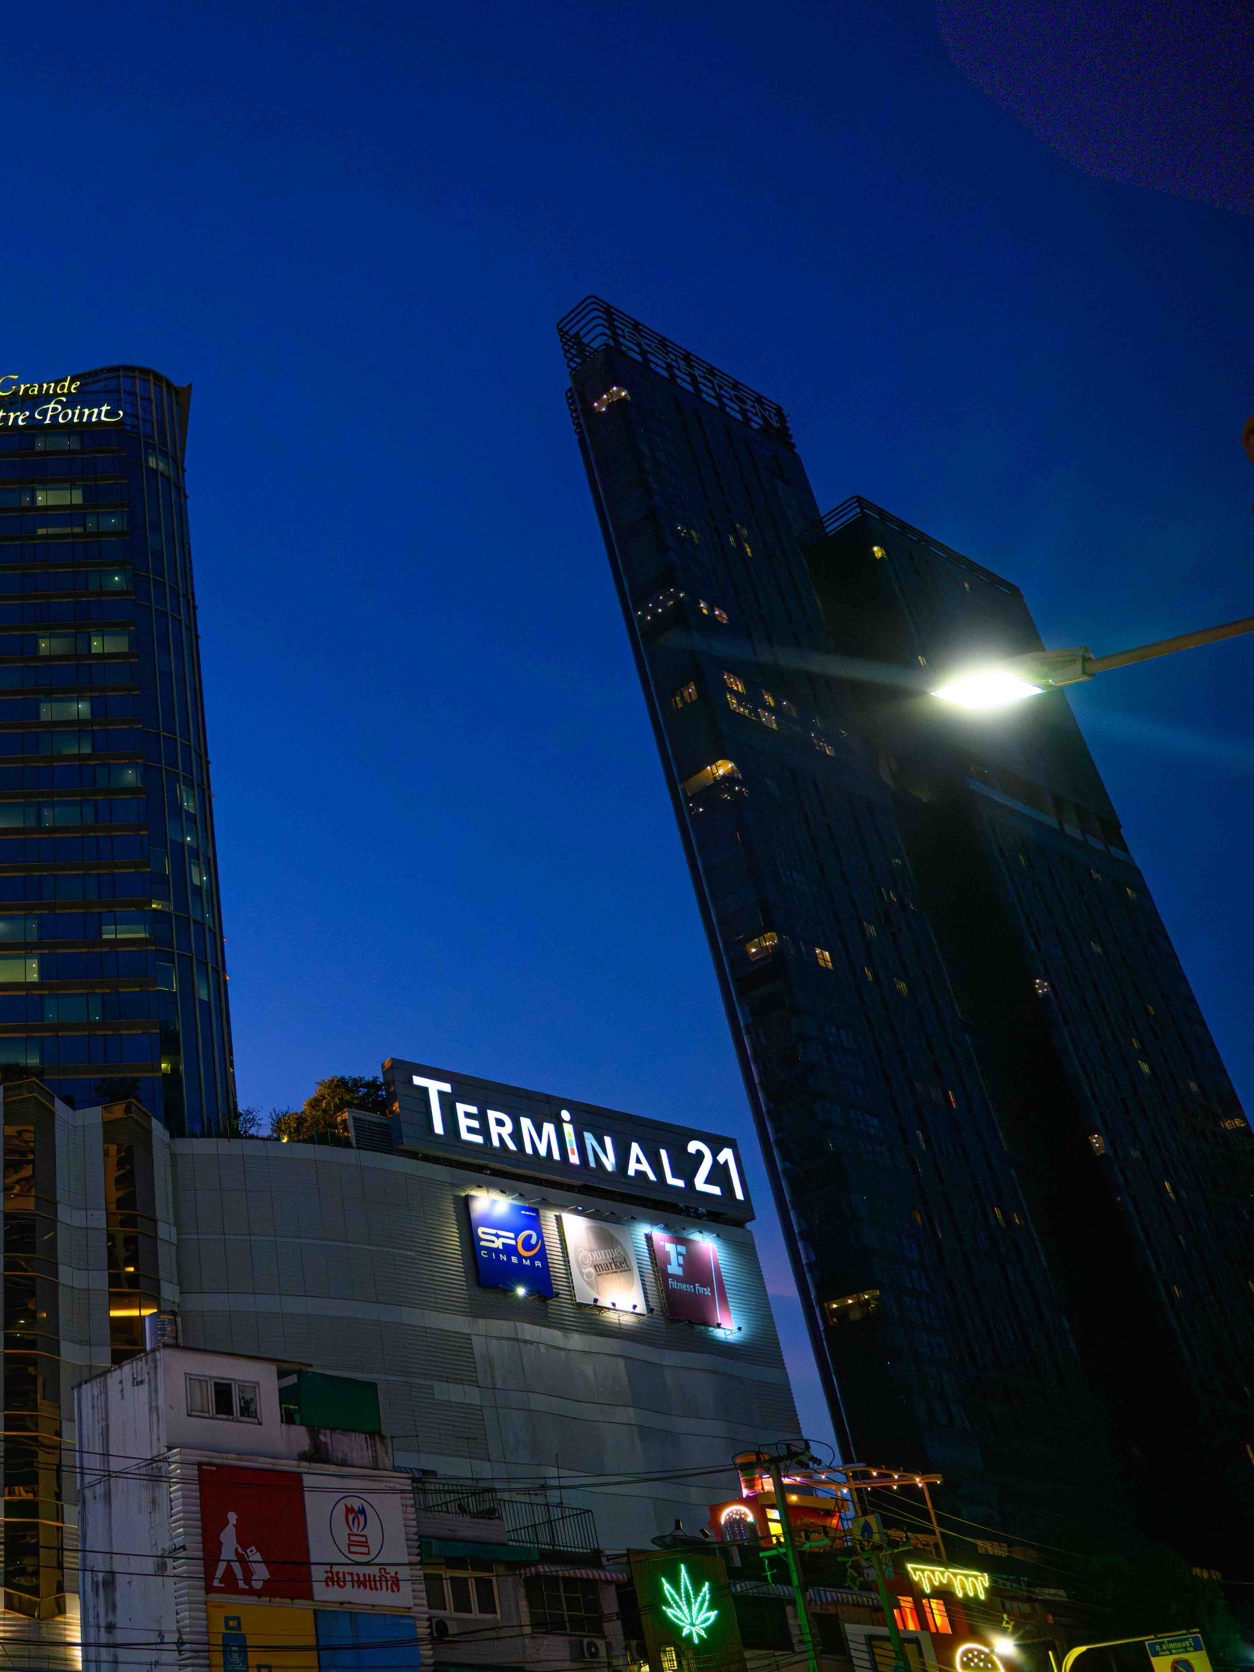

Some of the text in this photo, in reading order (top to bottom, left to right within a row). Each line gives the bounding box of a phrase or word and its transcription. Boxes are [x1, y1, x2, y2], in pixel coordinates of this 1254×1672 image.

[35, 397, 123, 424] Point
[481, 1250, 542, 1268] CINEMA
[593, 1257, 630, 1273] market
[668, 1278, 712, 1296] Fitness First
[324, 1565, 400, 1593] สยามแก๊ส
